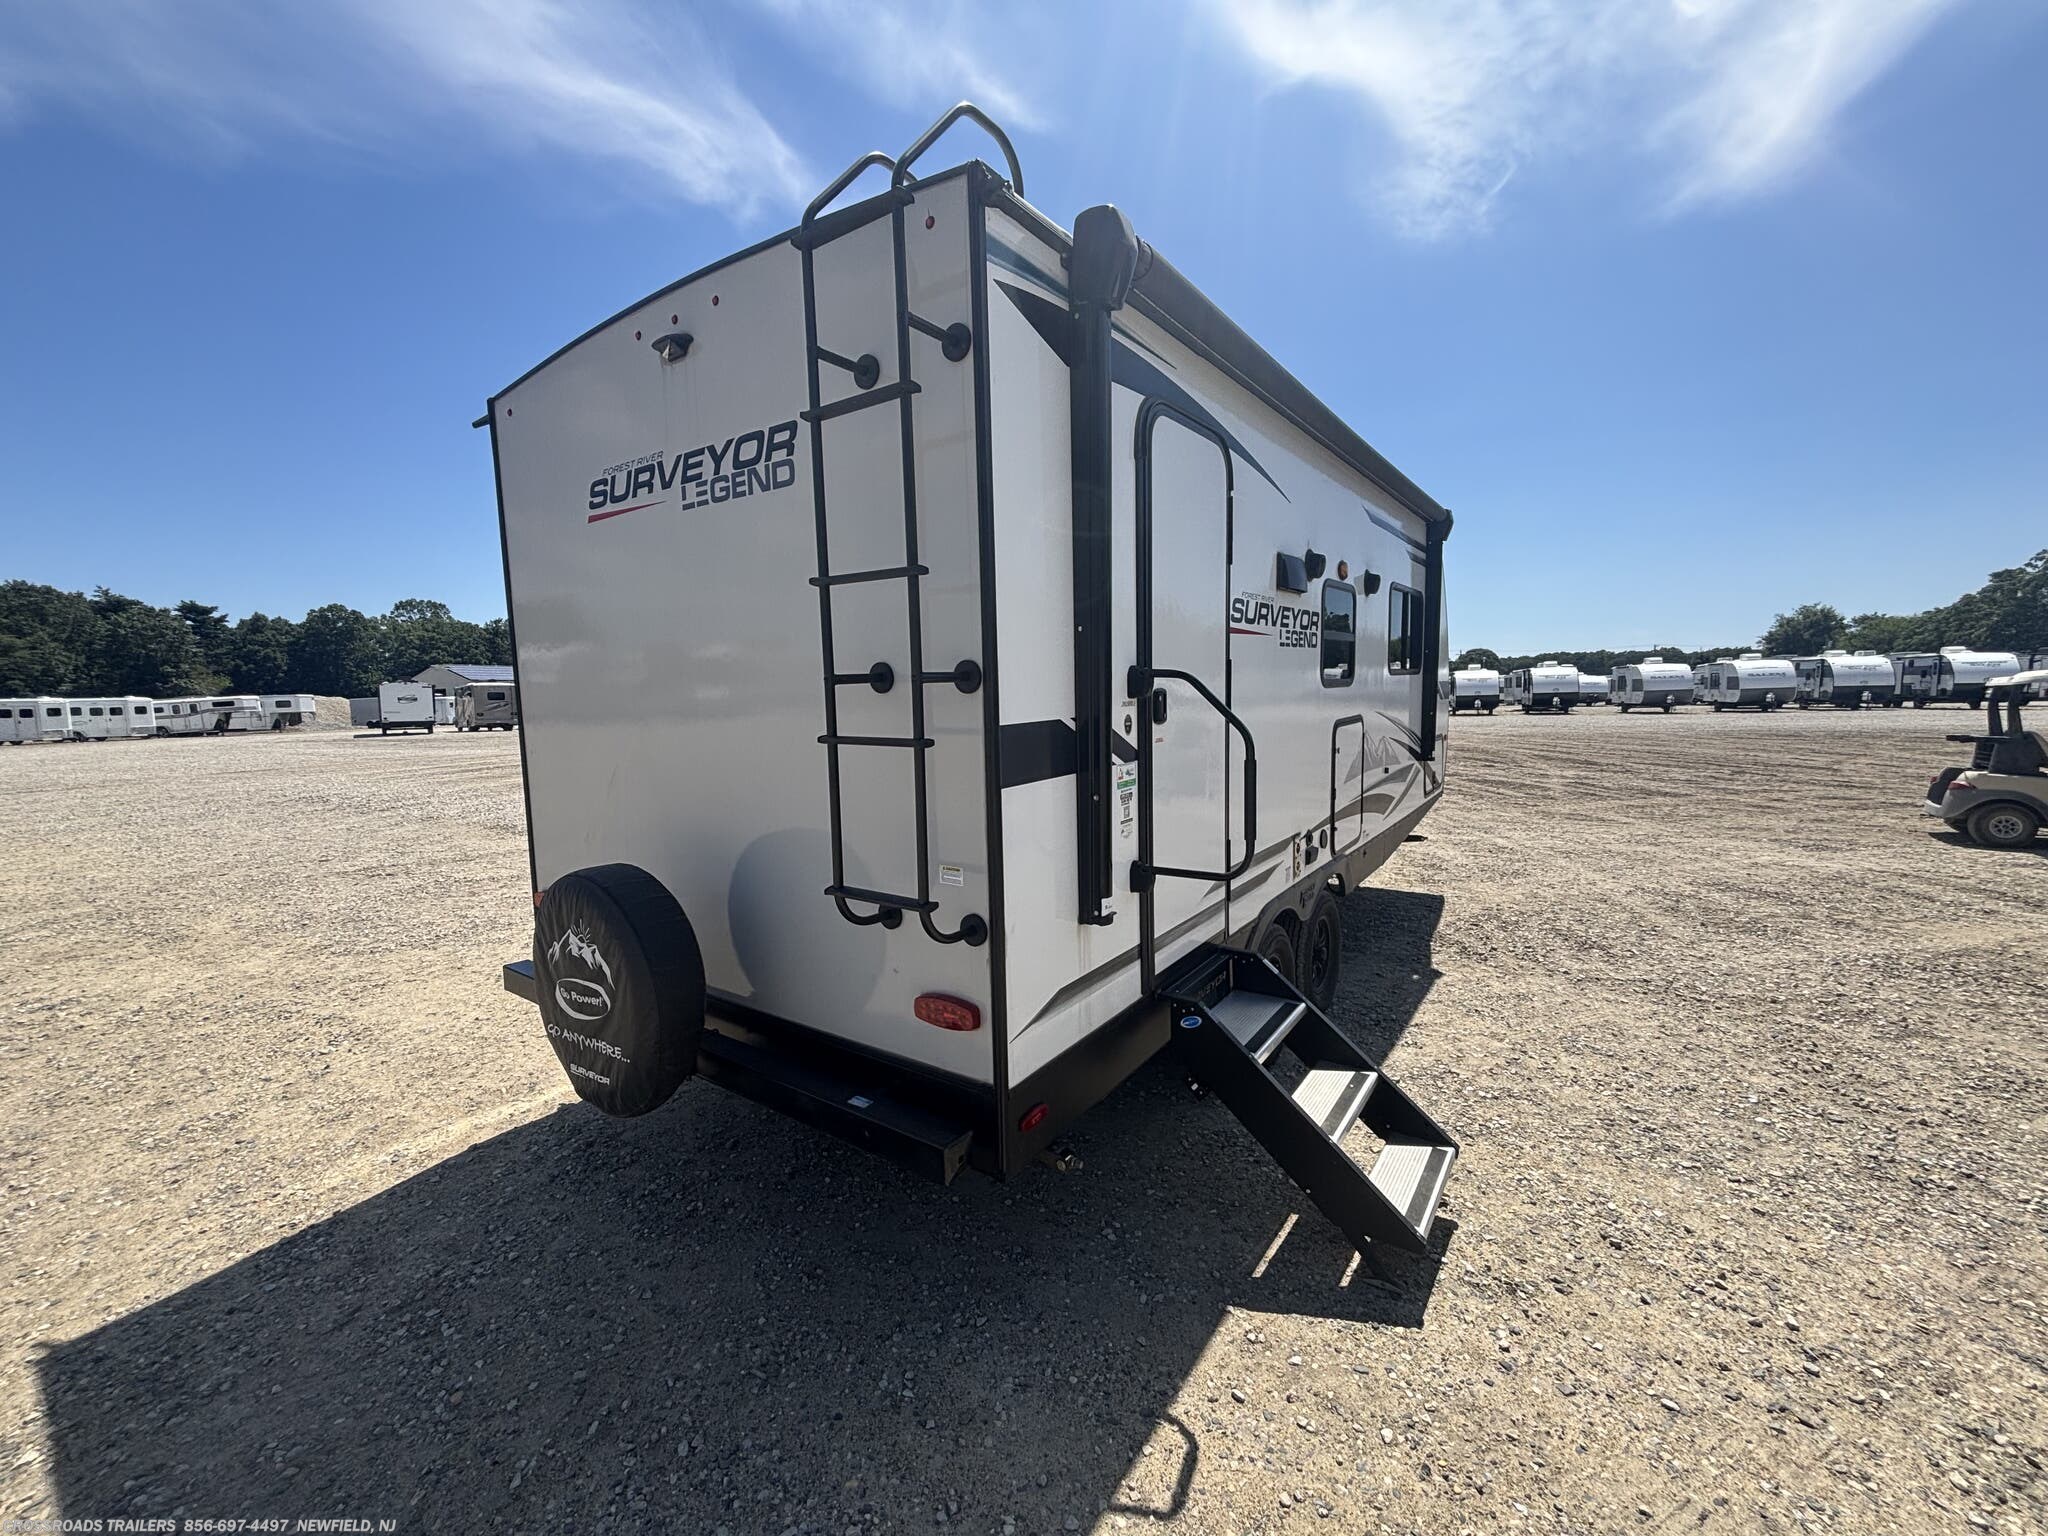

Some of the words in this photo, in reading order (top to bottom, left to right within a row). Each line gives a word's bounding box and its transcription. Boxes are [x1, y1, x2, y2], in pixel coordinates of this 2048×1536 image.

[588, 419, 798, 510] SURVEYOR
[602, 459, 635, 477] FOREST
[636, 451, 664, 466] RIVER
[681, 458, 796, 511] LEGEND
[1230, 597, 1320, 632] SURVEYOR
[1279, 629, 1318, 649] LEGEND
[560, 987, 570, 1000] Go
[547, 1023, 561, 1038] GO
[570, 1063, 610, 1085] SURVEYOR
